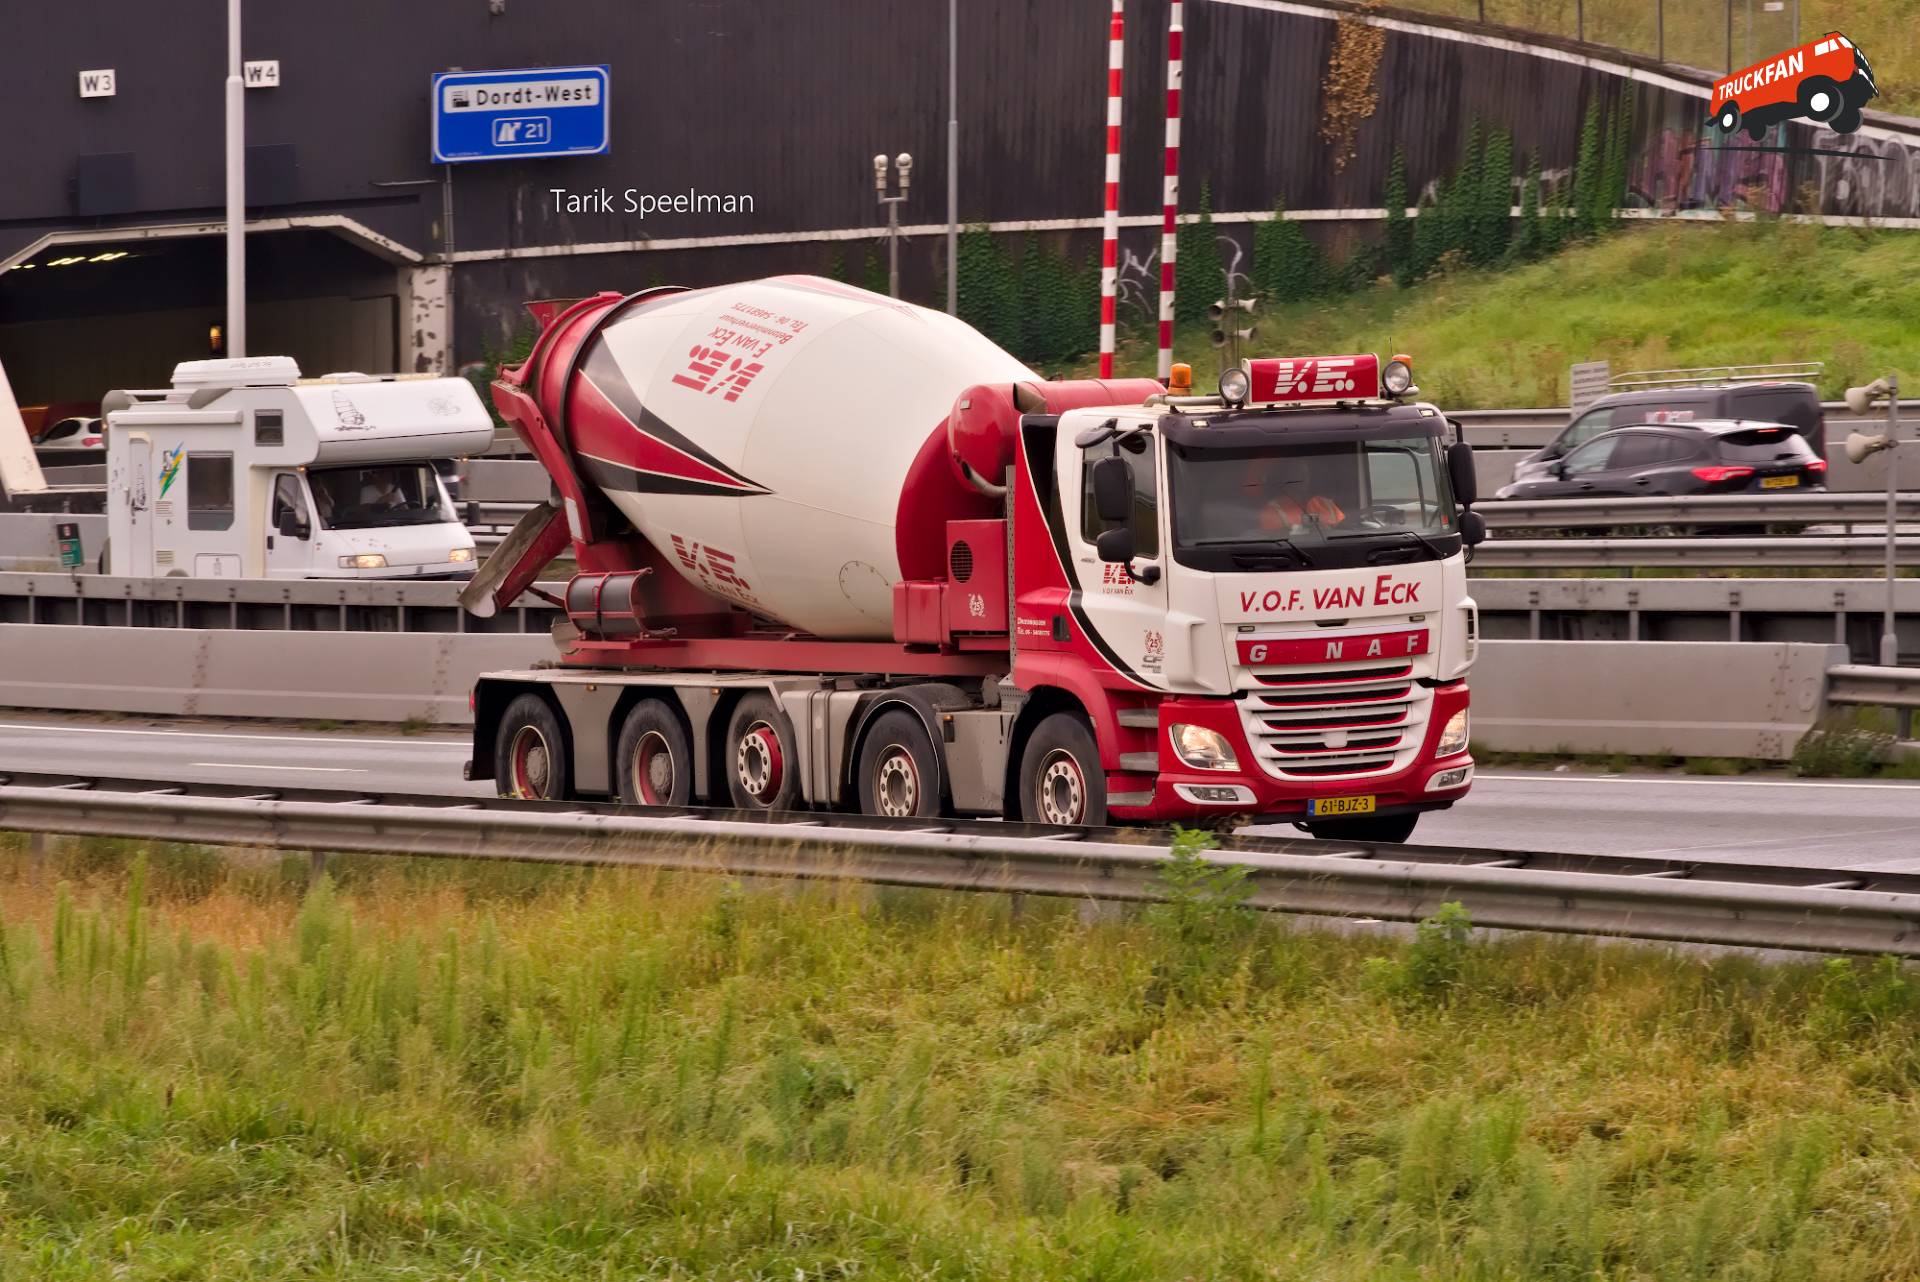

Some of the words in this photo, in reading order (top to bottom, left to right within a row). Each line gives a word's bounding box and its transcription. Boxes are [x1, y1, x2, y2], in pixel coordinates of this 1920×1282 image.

[247, 66, 277, 82] W4
[83, 74, 112, 92] W3
[476, 85, 592, 106] Dordt-West
[525, 123, 545, 139] 21
[731, 334, 761, 351] VAN
[1240, 590, 1304, 613] V.O.F.
[1313, 586, 1365, 610] VAN
[1374, 574, 1422, 606] ECK
[1321, 798, 1369, 813] 61-BJZ-3
